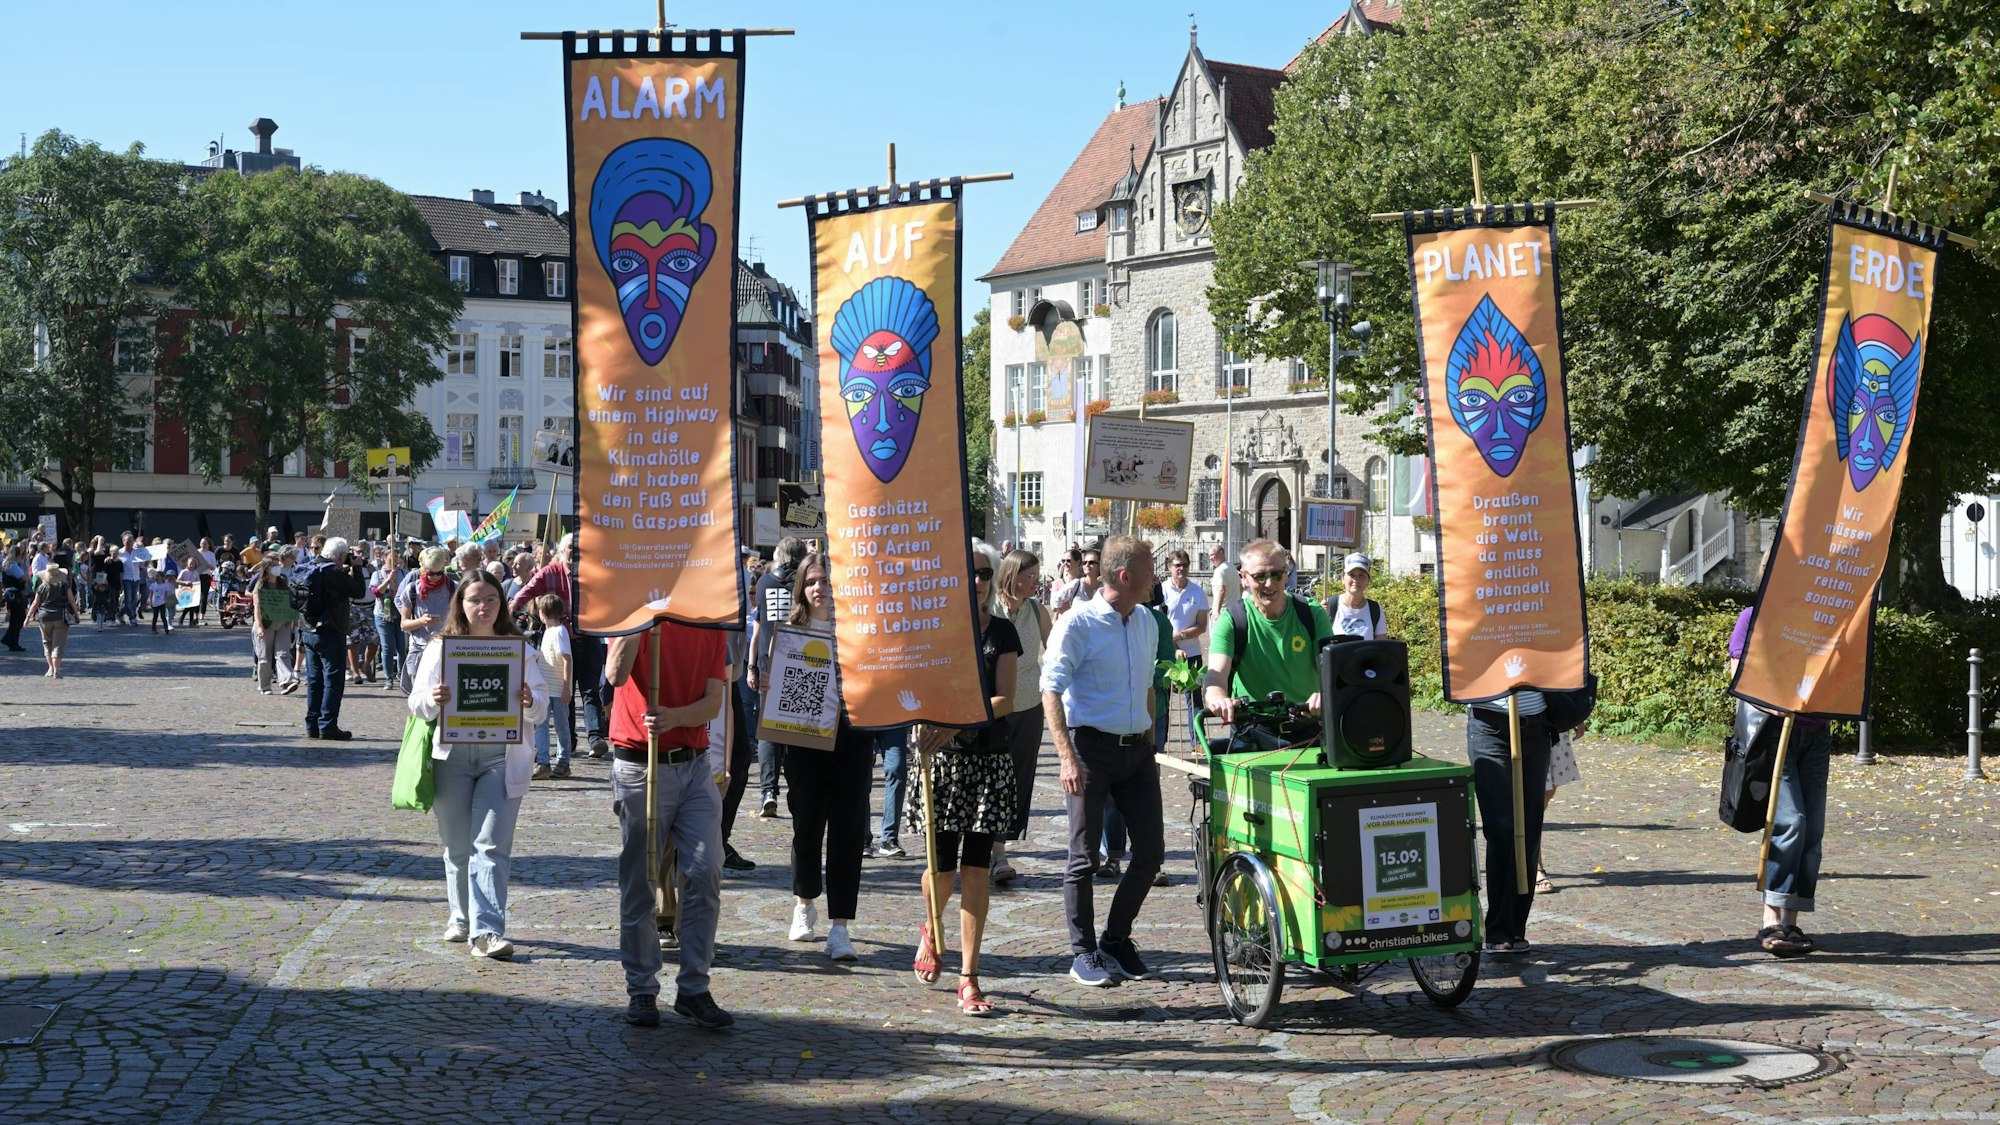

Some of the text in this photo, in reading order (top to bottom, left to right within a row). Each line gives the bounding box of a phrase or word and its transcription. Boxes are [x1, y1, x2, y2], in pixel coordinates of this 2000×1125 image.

[581, 75, 726, 121] ALARM
[843, 220, 926, 274] AUF
[1422, 241, 1543, 285] PLANET
[1849, 244, 1925, 299] ERDE
[597, 383, 710, 402] Wir sind auf
[588, 407, 719, 425] einem Highway
[627, 429, 679, 445] in die
[608, 449, 700, 467] Klimahölle
[610, 471, 699, 487] und haben
[602, 490, 708, 508] den Fuß auf
[1473, 493, 1540, 510] Draußen
[848, 499, 929, 519] Geschätzt
[1842, 504, 1864, 522] Wir
[592, 512, 720, 531] dem Gaspedal.
[839, 517, 942, 539] verlieren wir
[1483, 511, 1533, 527] brennt
[1476, 528, 1544, 545] die Welt,
[1825, 523, 1872, 542] müssen
[850, 538, 931, 558] 150 Arten
[1478, 548, 1543, 563] da muss
[1829, 541, 1861, 559] nicht
[846, 555, 941, 579] pro Tag und
[1485, 563, 1539, 580] endlich
[1799, 554, 1876, 577] „das Klima“
[838, 575, 959, 597] damit zerstören
[1476, 582, 1551, 600] gehandelt
[1813, 575, 1855, 594] retten,
[849, 595, 947, 616] wir das Netz
[1484, 598, 1544, 615] werden!
[1805, 591, 1854, 610] sondern
[855, 615, 945, 635] des Lebens.
[462, 678, 504, 690] 15.09.
[789, 724, 821, 735] EINLADUNG
[1366, 816, 1429, 828] VOR DER HAUSTÜR!
[1370, 810, 1427, 821] KLIMASCHUTZ BEGINNT
[1379, 849, 1422, 866] 15.09.
[1369, 931, 1450, 950] christiania bikes
